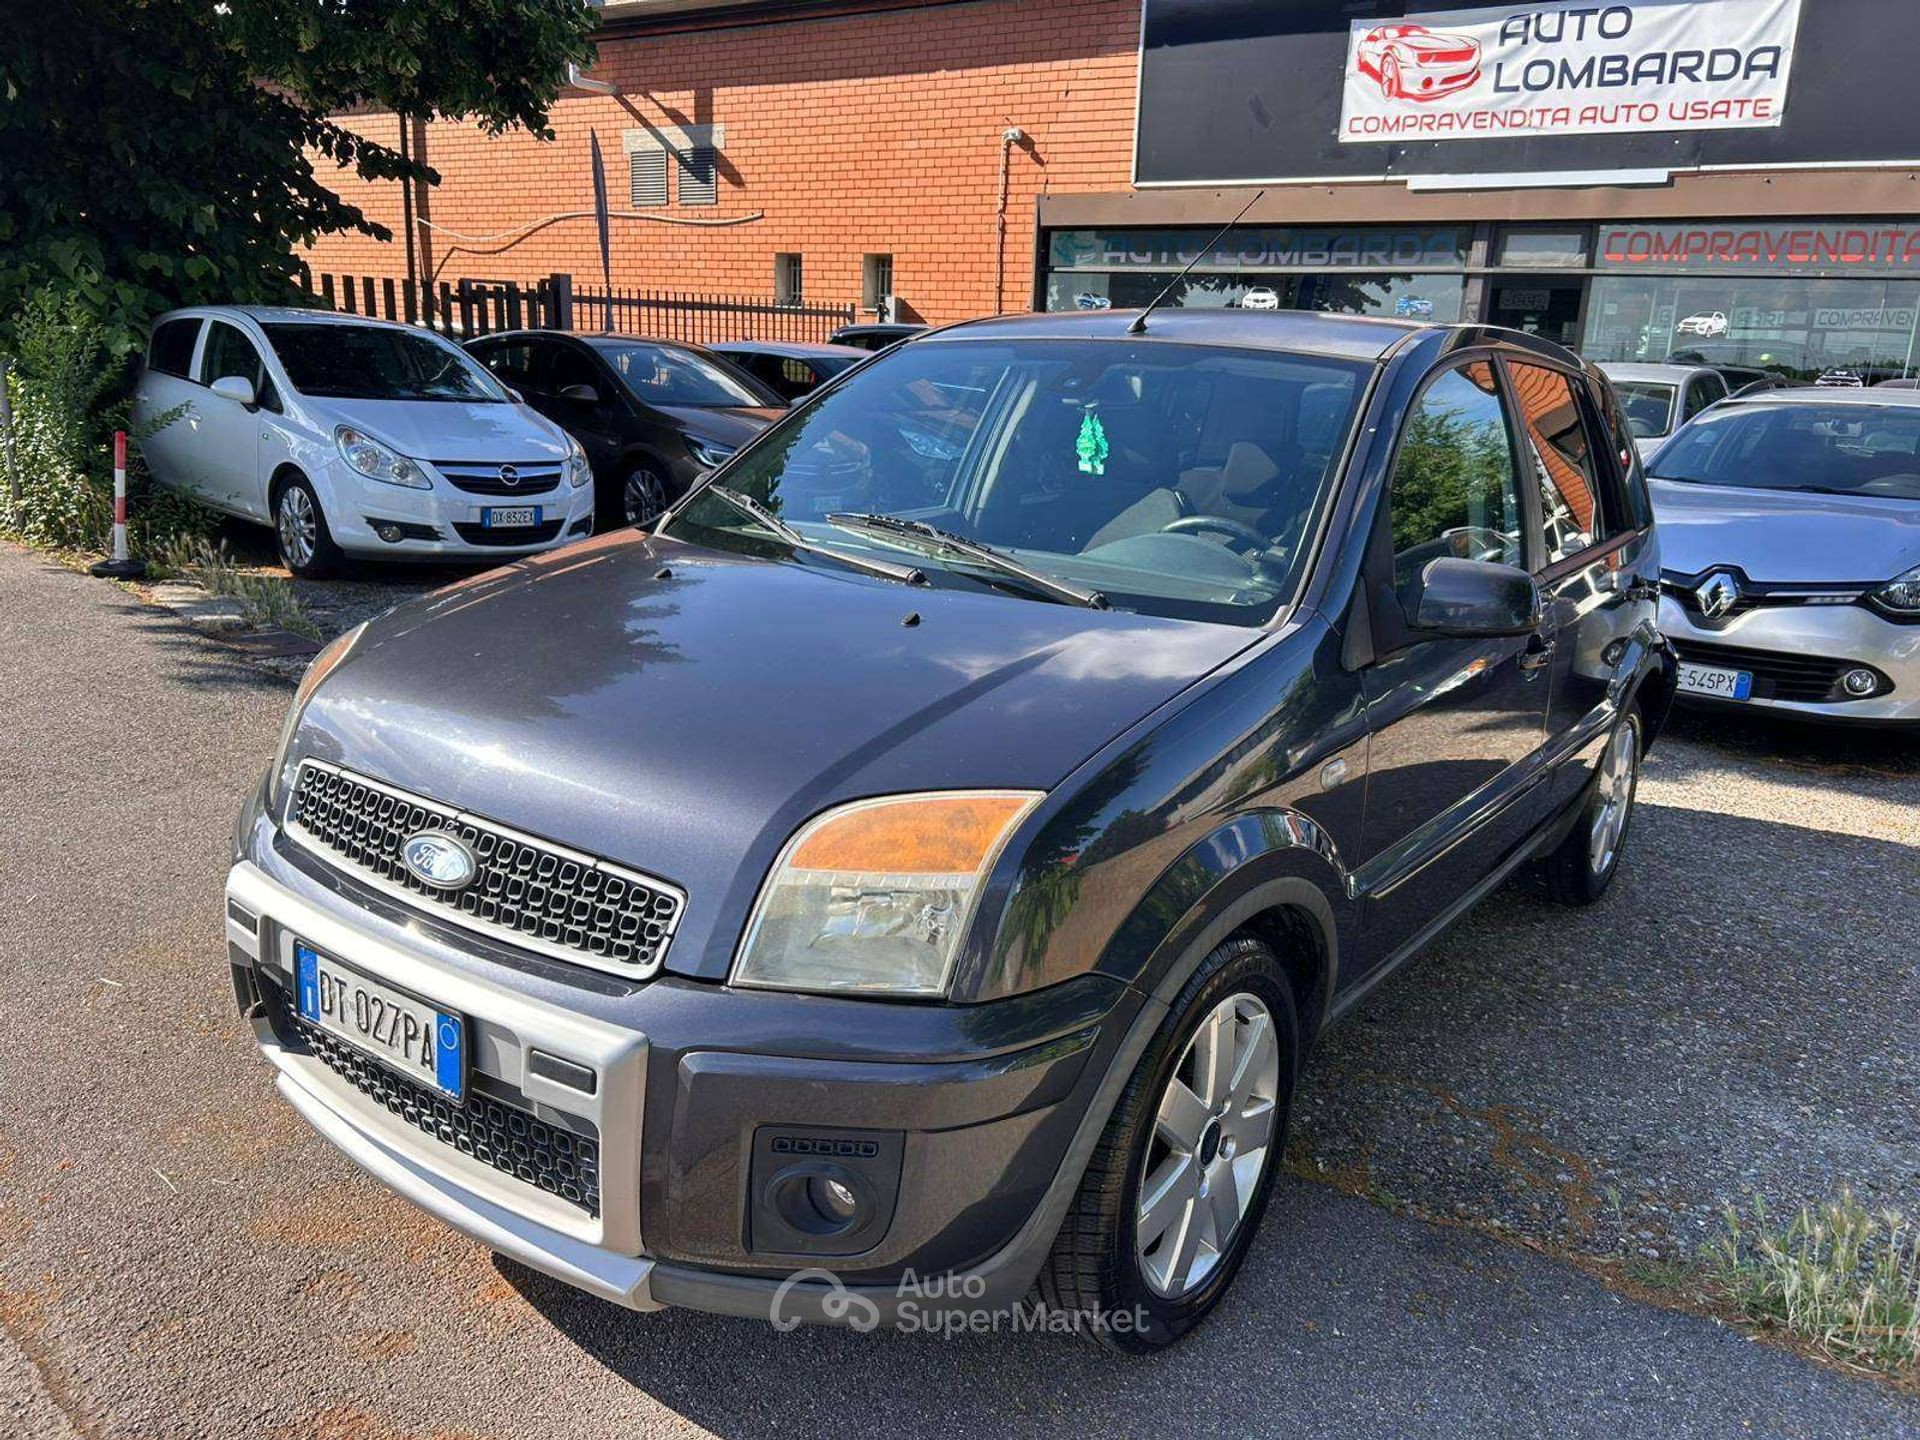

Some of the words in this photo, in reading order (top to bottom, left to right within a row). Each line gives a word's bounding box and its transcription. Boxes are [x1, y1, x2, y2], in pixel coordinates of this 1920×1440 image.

[1498, 6, 1633, 47] AUTO
[1493, 46, 1782, 94] LOMBARDA
[1349, 107, 1570, 134] COMPRAVENDITA
[1579, 103, 1659, 125] AUTO
[1669, 98, 1772, 121] USATE
[1213, 232, 1457, 265] LOMBARDA
[1688, 670, 1736, 693] 545PX
[320, 970, 347, 1025] DT
[355, 988, 436, 1072] 027PA
